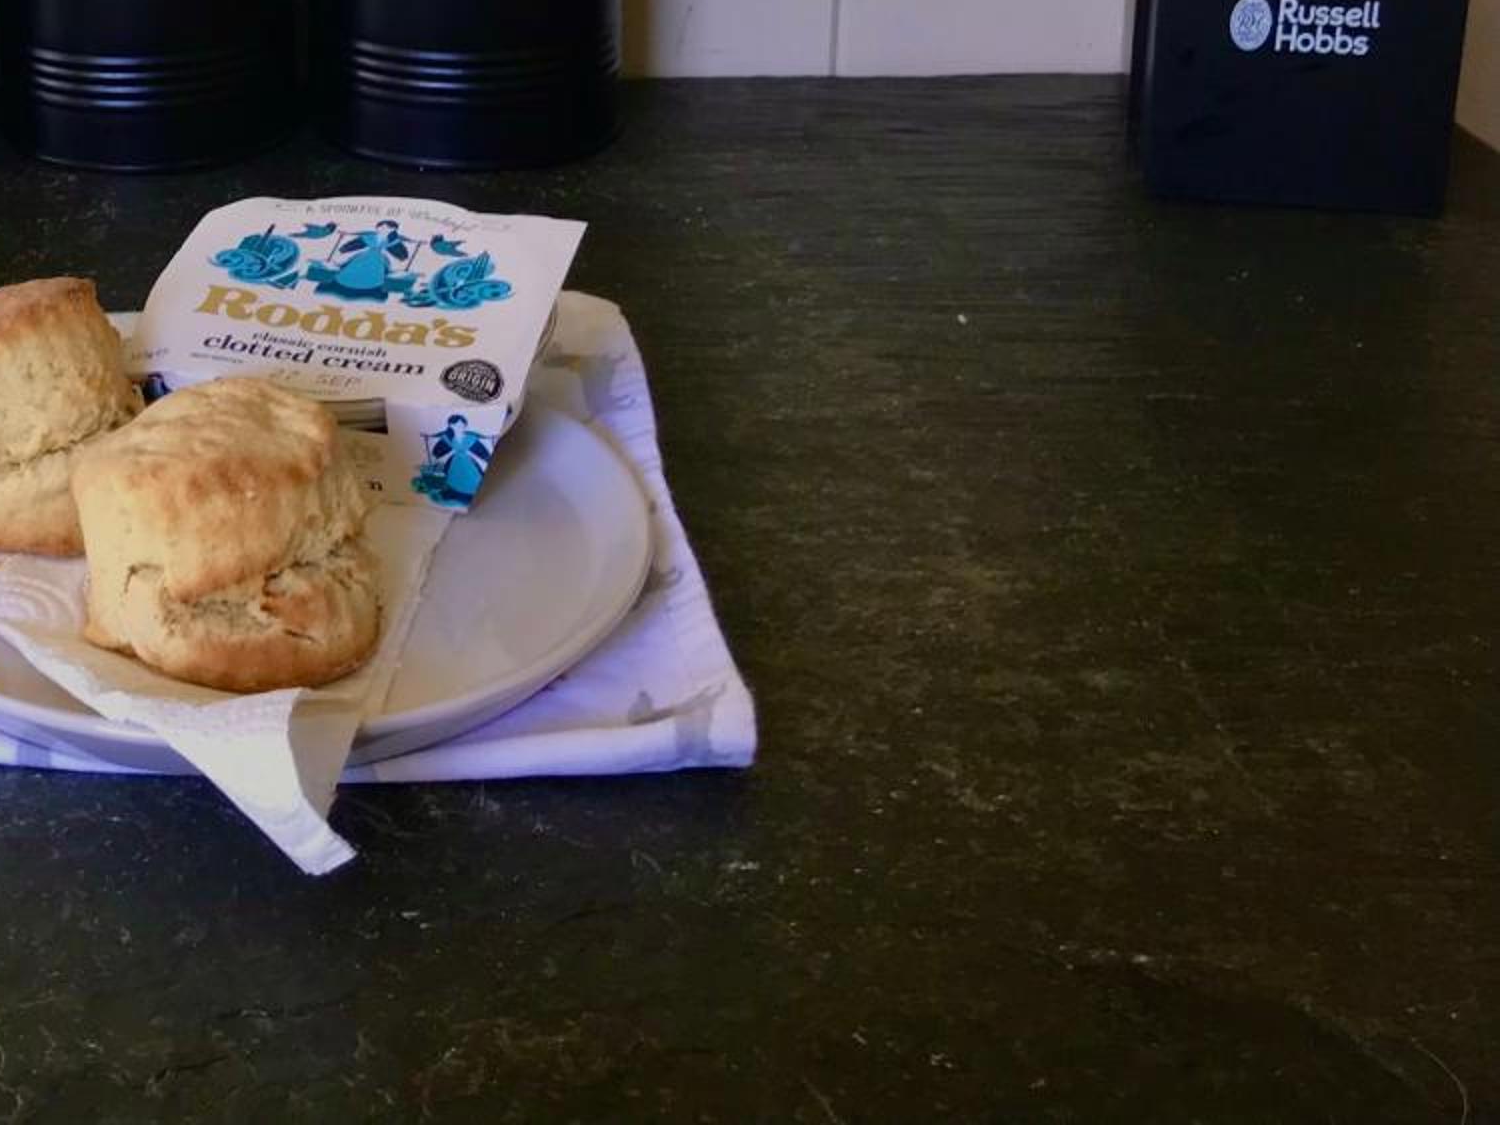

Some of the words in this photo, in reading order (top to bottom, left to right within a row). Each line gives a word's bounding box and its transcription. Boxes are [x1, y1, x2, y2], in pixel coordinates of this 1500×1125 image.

[1274, 24, 1370, 56] Hobbs
[195, 284, 480, 349] Rodda's
[203, 334, 314, 364] clotted
[322, 355, 425, 376] cream
